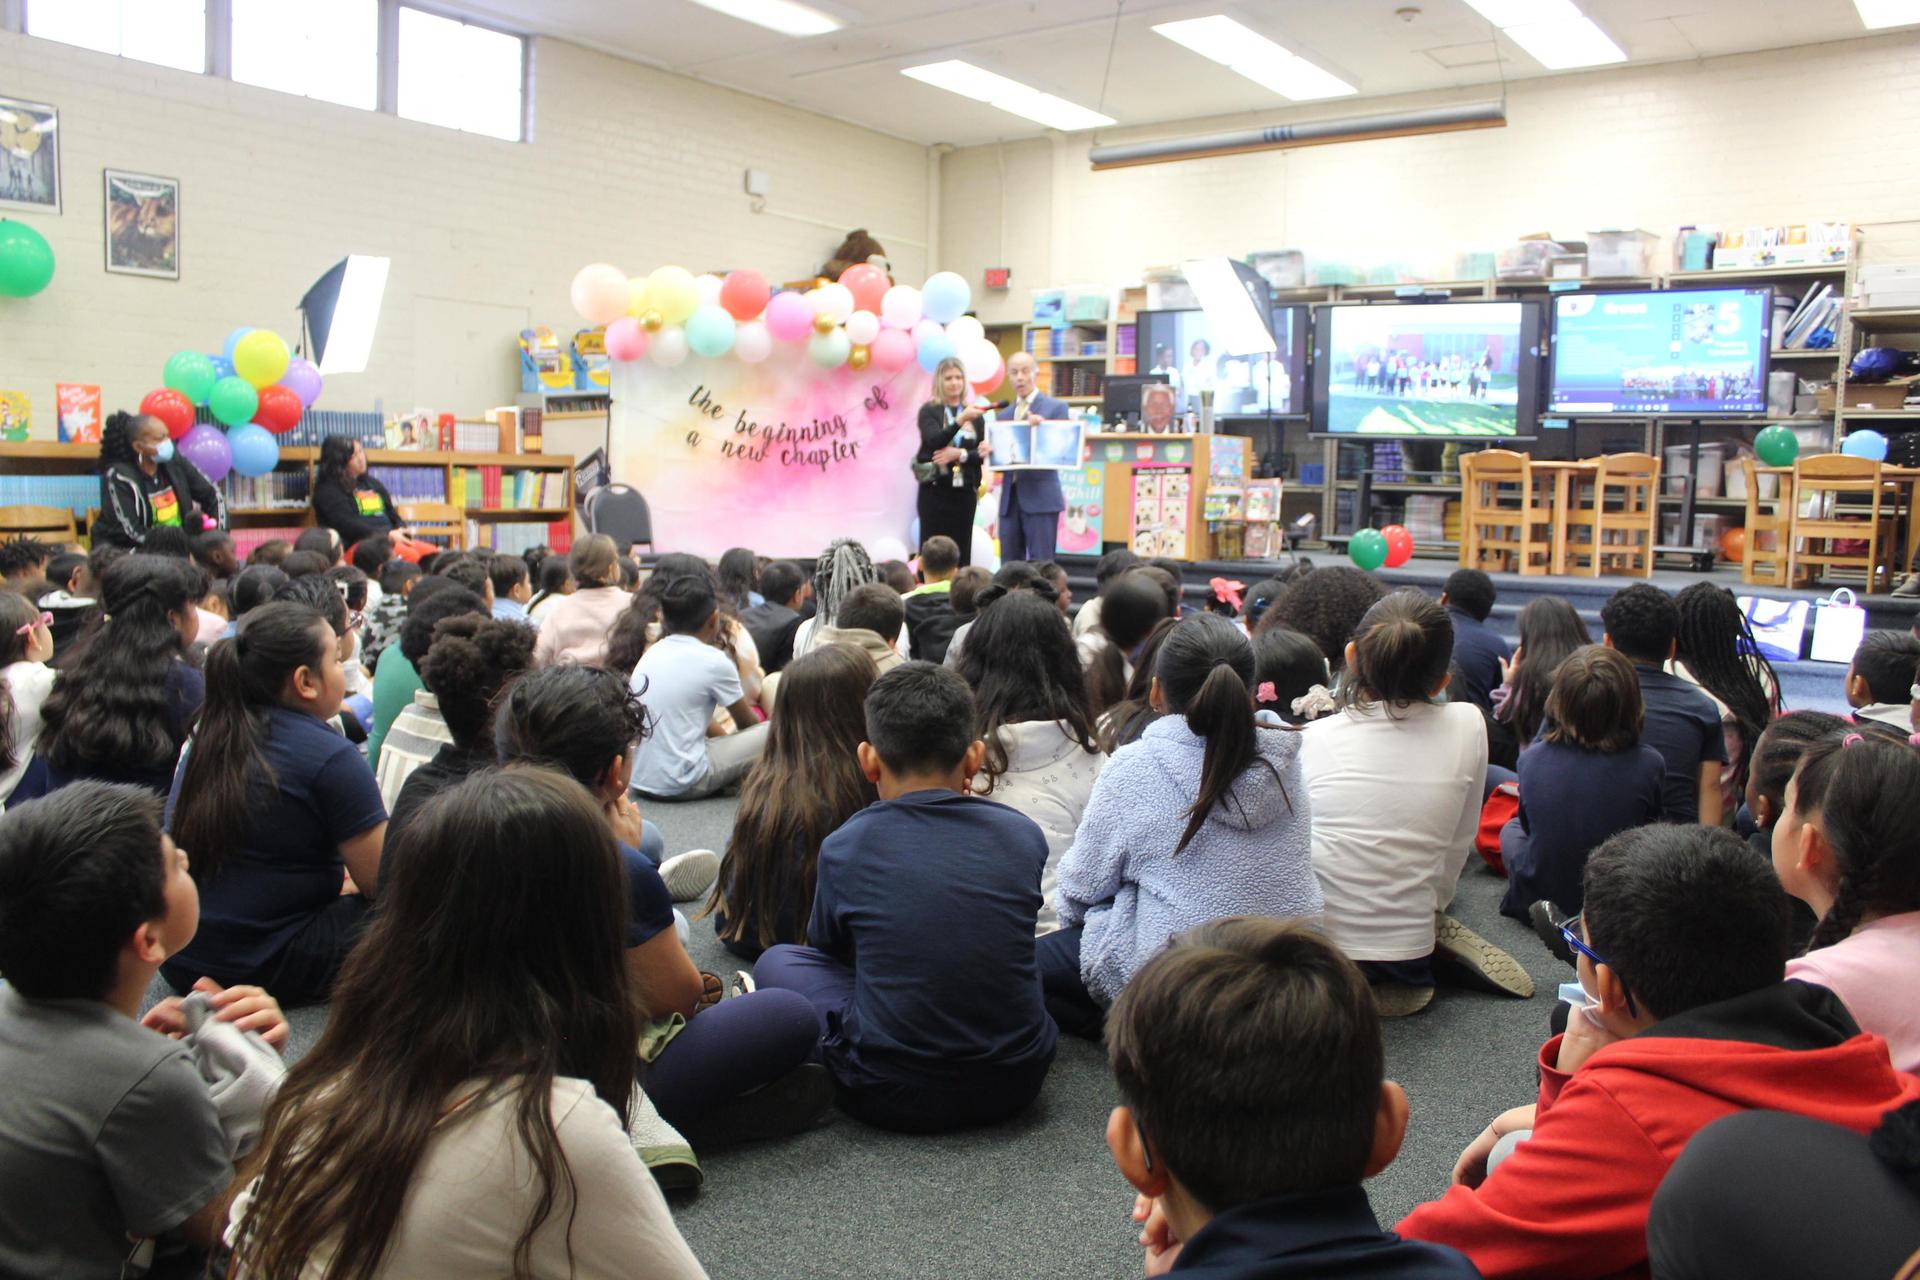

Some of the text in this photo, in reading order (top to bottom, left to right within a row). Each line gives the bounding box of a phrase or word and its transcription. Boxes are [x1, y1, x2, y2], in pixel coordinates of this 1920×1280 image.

[1716, 302, 1740, 335] 5
[687, 384, 889, 447] the beginning of
[687, 430, 862, 472] a new chapter
